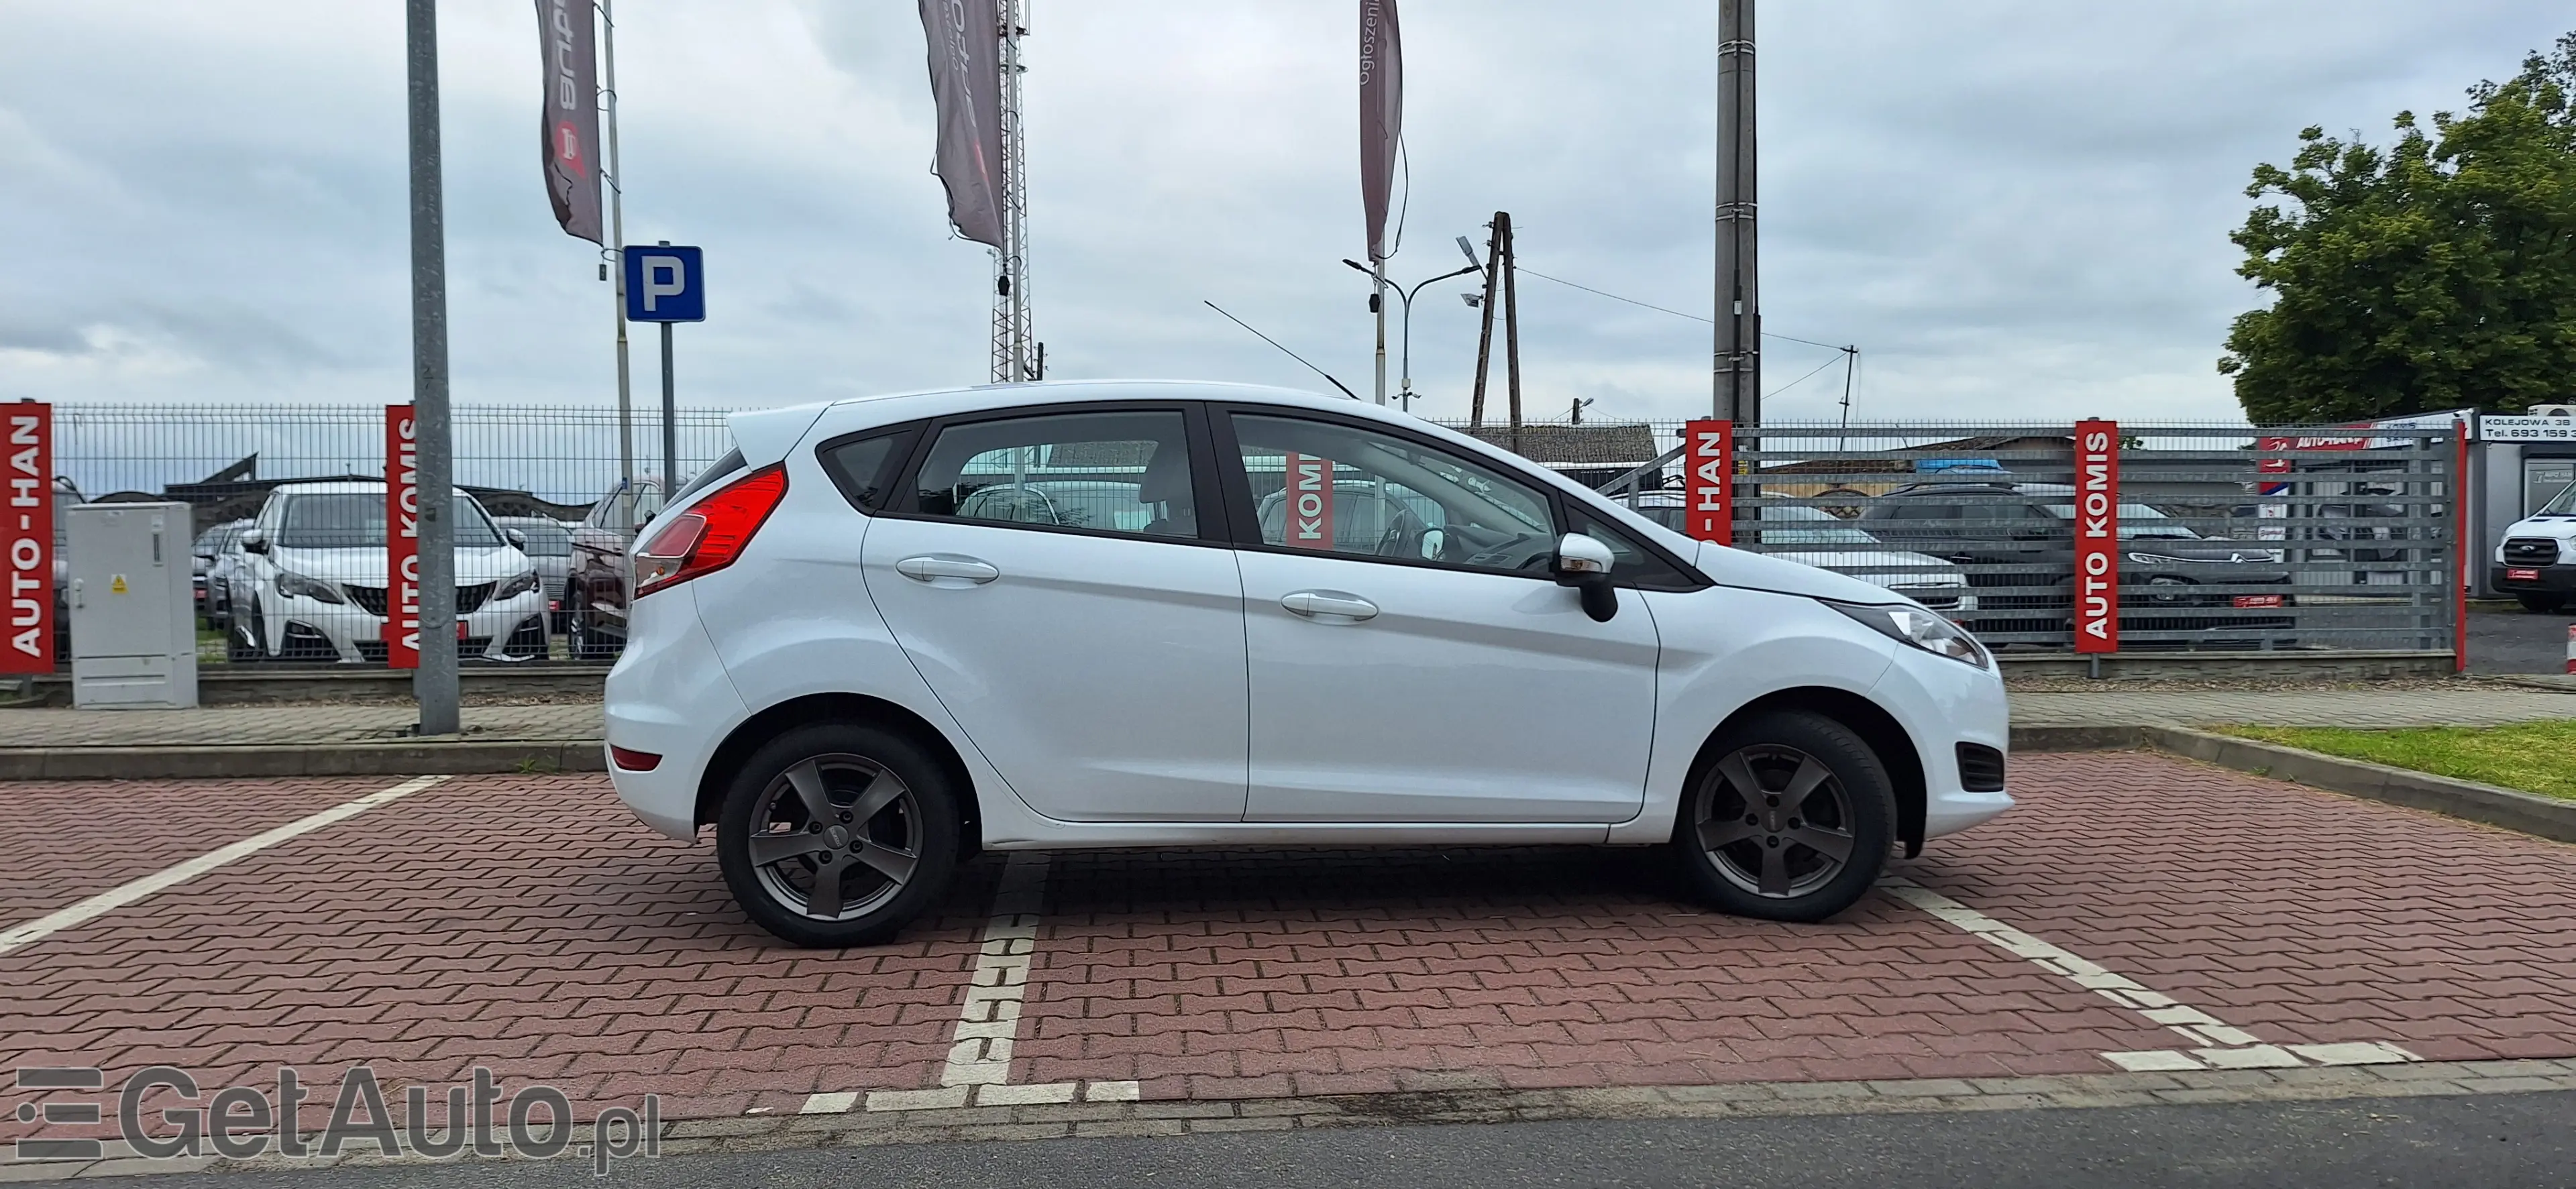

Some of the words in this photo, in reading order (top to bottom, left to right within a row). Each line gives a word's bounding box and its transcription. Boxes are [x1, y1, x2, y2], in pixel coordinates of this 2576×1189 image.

[1360, 0, 1380, 85] Ogłoszeni
[641, 256, 685, 311] P
[2485, 429, 2508, 437] Tel.
[2511, 429, 2539, 437] 693
[2542, 429, 2568, 437] 159
[2085, 432, 2108, 538] KOMIS
[2085, 552, 2108, 640] AUTO
